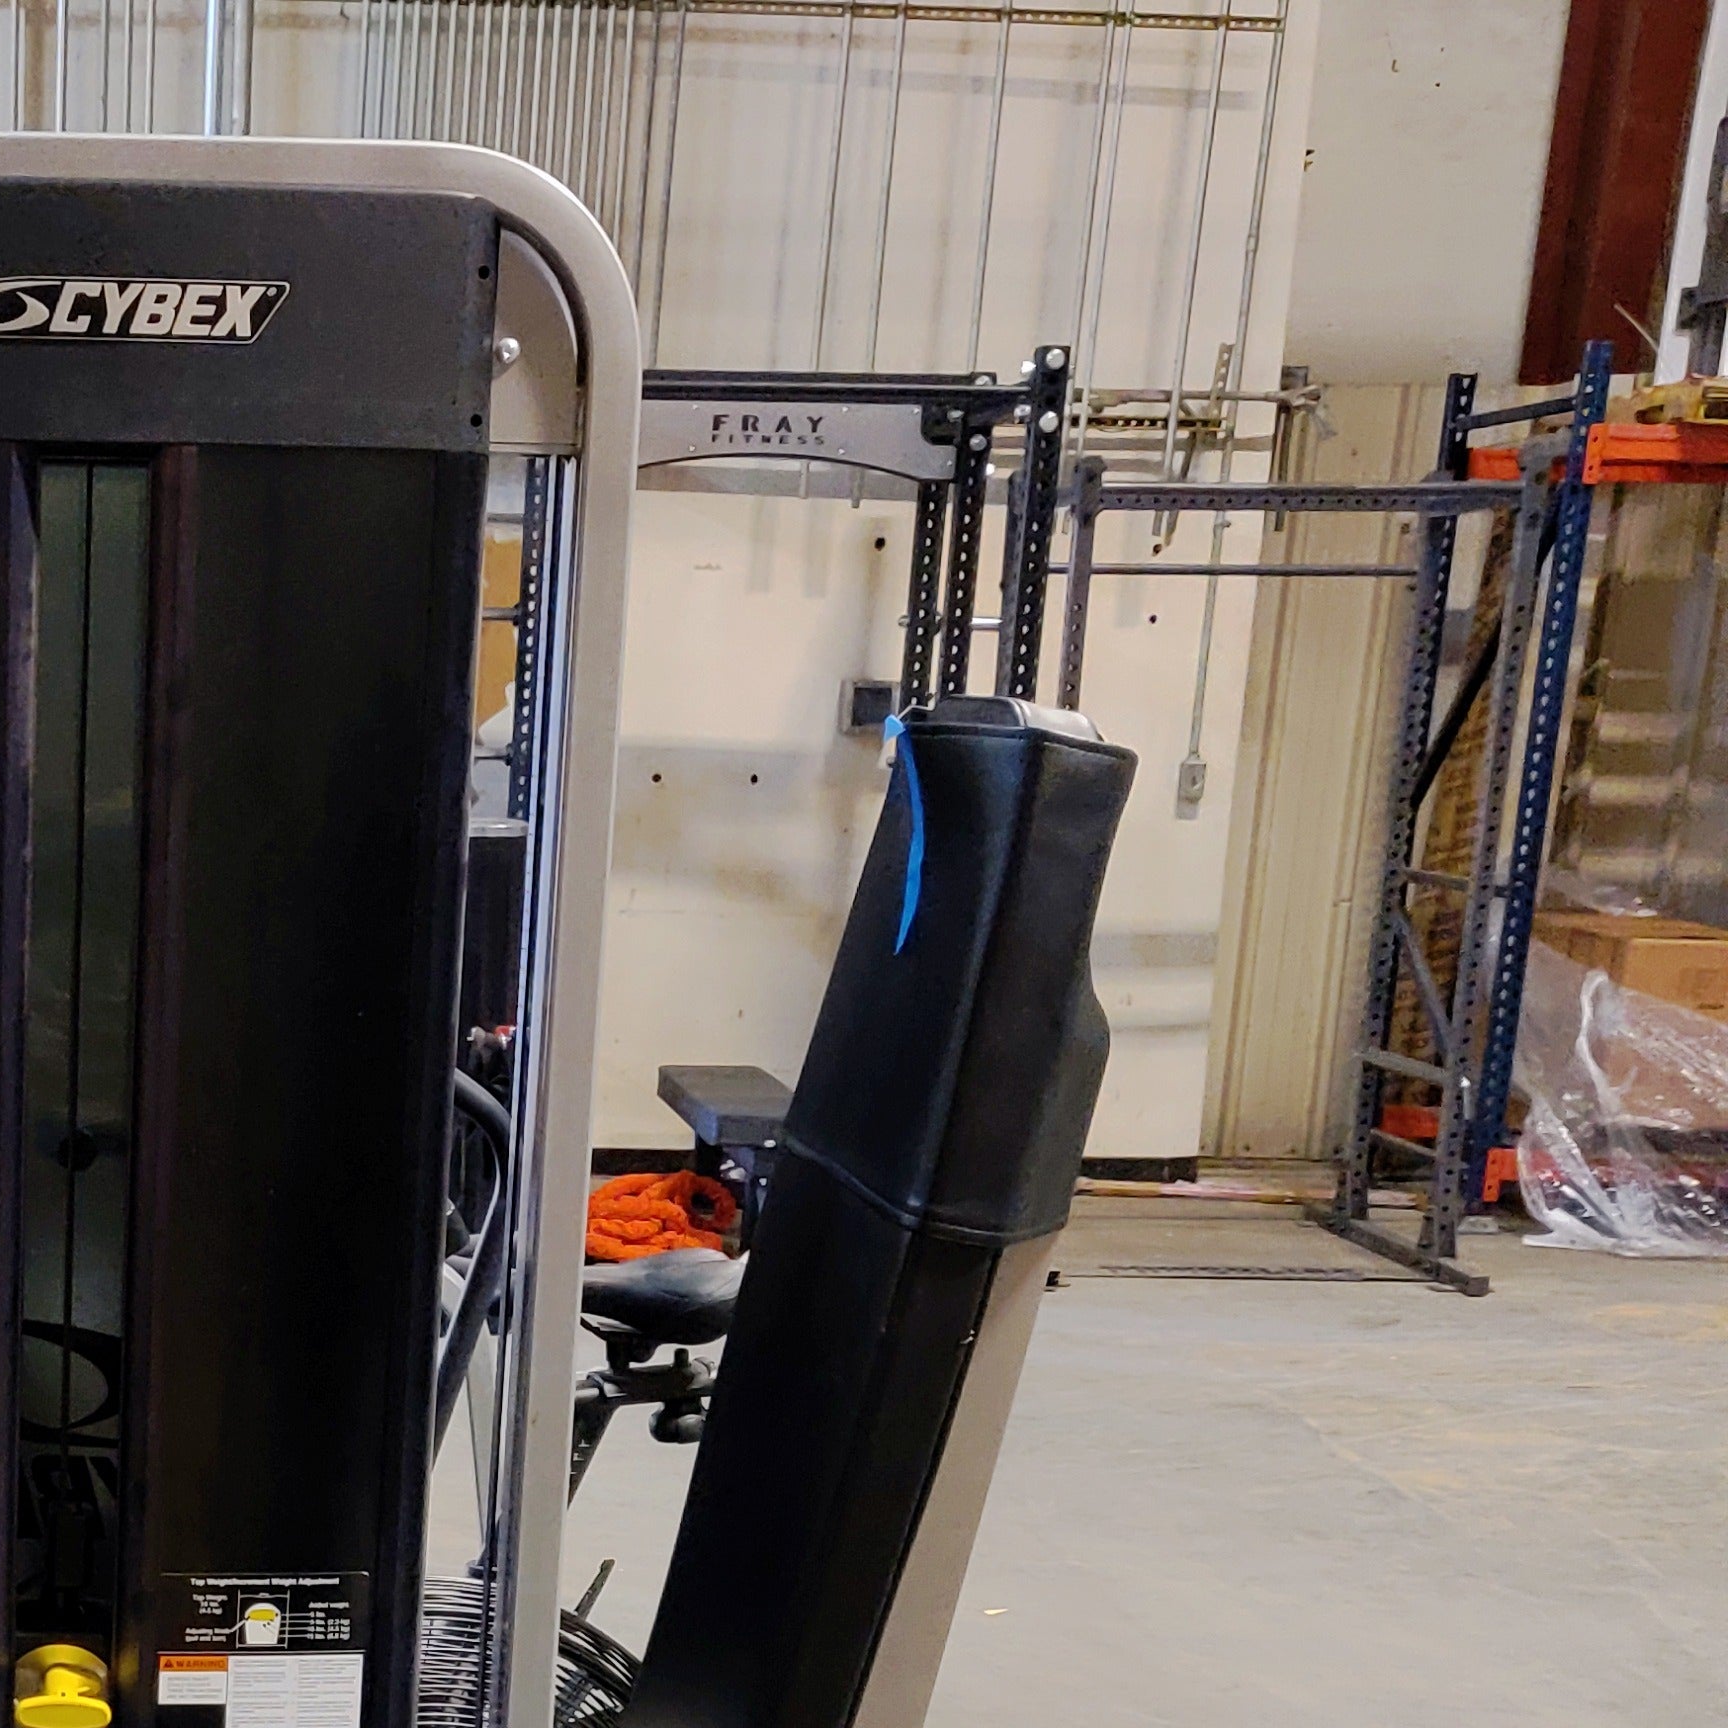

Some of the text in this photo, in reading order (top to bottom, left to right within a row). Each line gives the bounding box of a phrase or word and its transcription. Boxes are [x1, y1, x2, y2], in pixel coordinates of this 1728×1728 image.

[48, 280, 267, 338] CYBEX
[712, 414, 825, 433] FRAY
[712, 434, 825, 445] FITNESS
